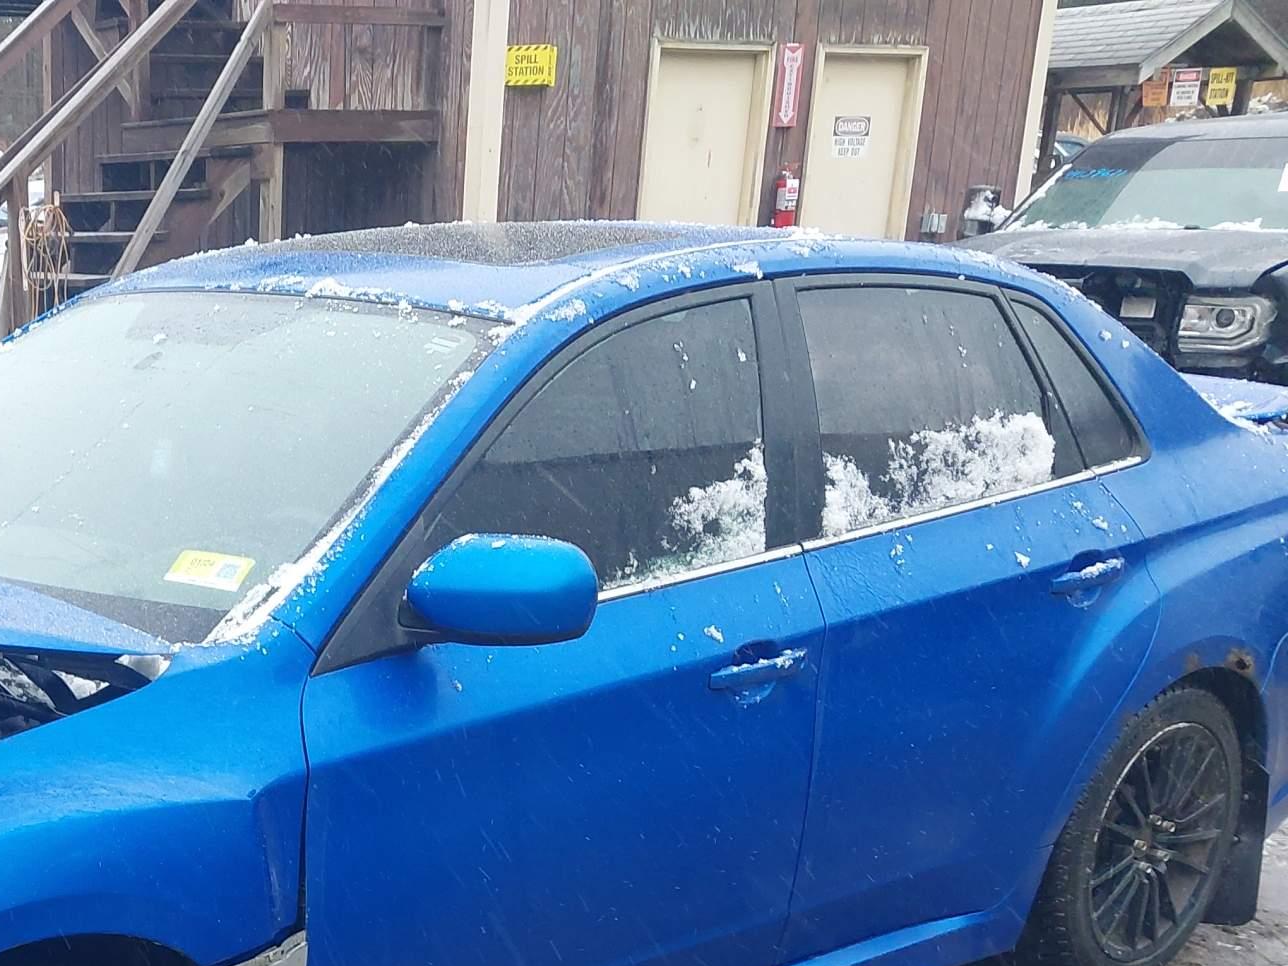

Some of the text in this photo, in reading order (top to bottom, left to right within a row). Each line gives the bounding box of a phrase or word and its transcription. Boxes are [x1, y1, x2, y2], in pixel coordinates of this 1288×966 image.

[514, 53, 539, 65] SPILL
[507, 65, 545, 77] STATION
[1208, 87, 1229, 100] STATION
[838, 121, 866, 132] DANGER
[834, 137, 866, 147] HIGH VOLTAGE
[838, 147, 861, 157] KEEP OUT
